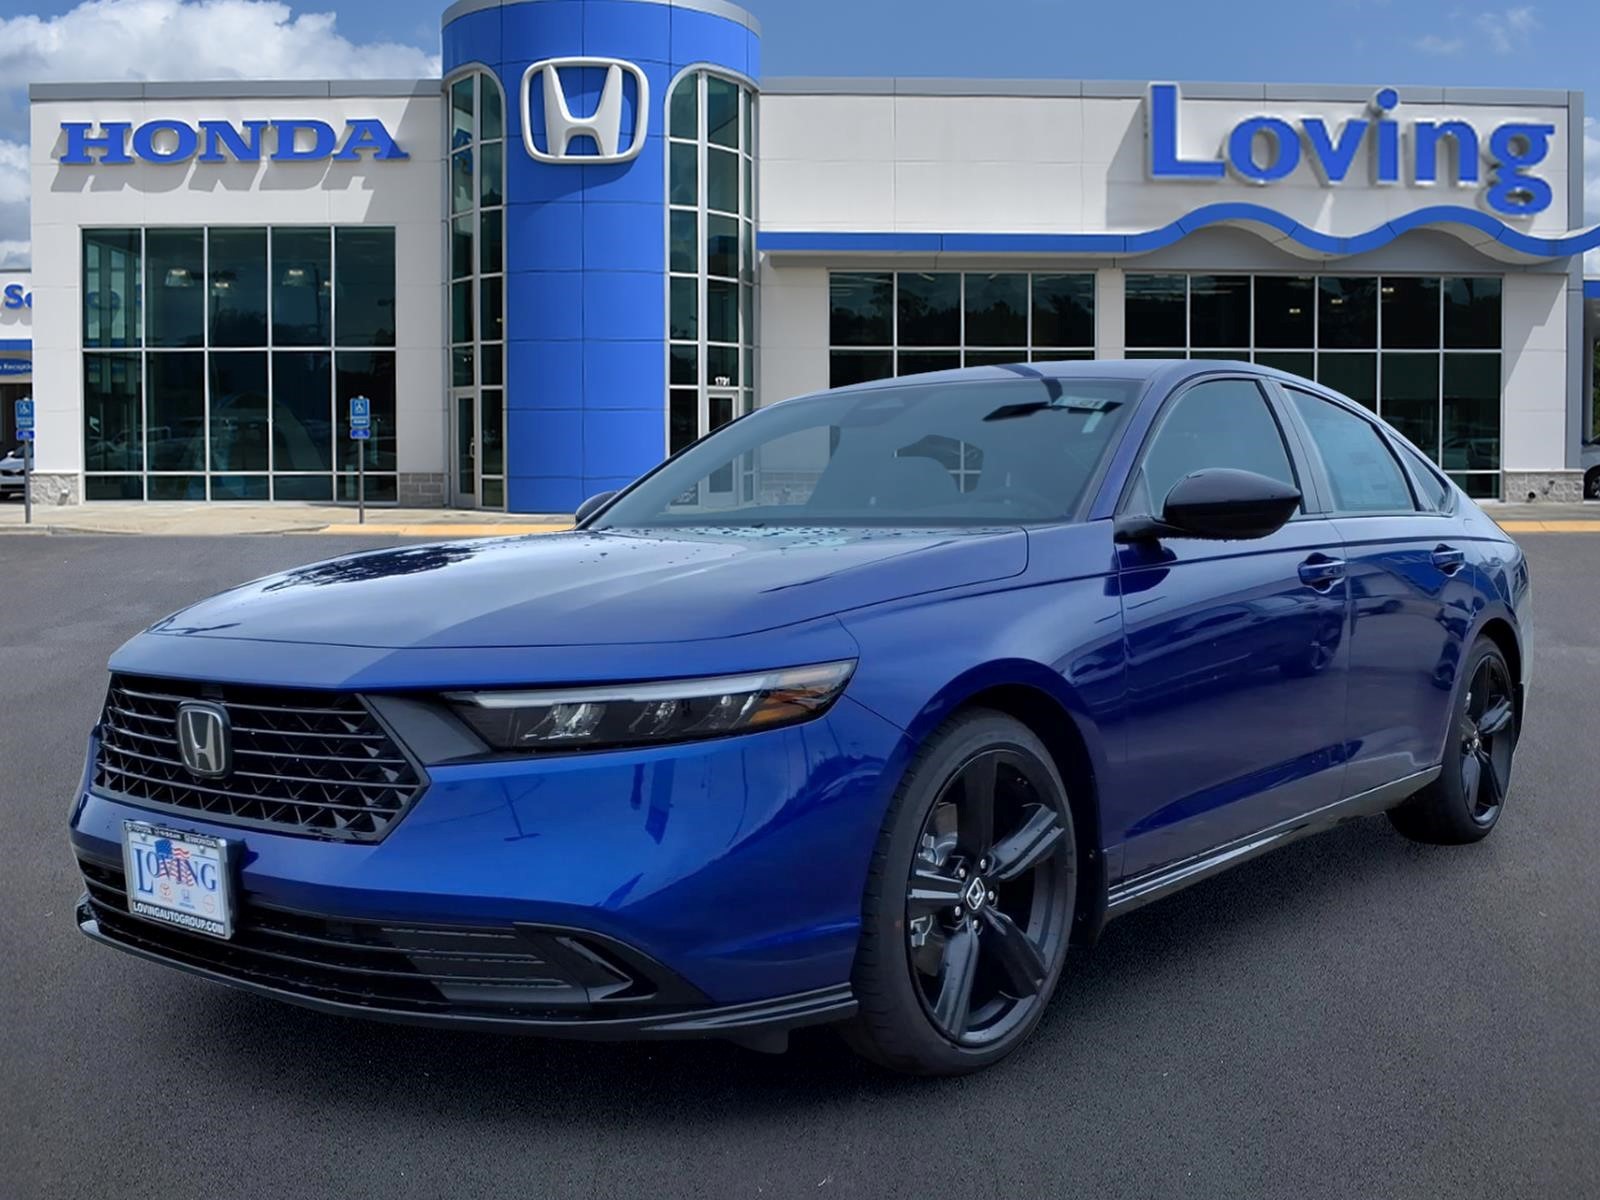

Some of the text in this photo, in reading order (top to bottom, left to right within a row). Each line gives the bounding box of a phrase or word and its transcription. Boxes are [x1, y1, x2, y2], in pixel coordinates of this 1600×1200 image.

[60, 119, 410, 164] HONDA
[1148, 82, 1556, 217] Loving
[134, 848, 217, 895] LOVING
[133, 901, 225, 934] LOVINGAUTOGROUP.COM
